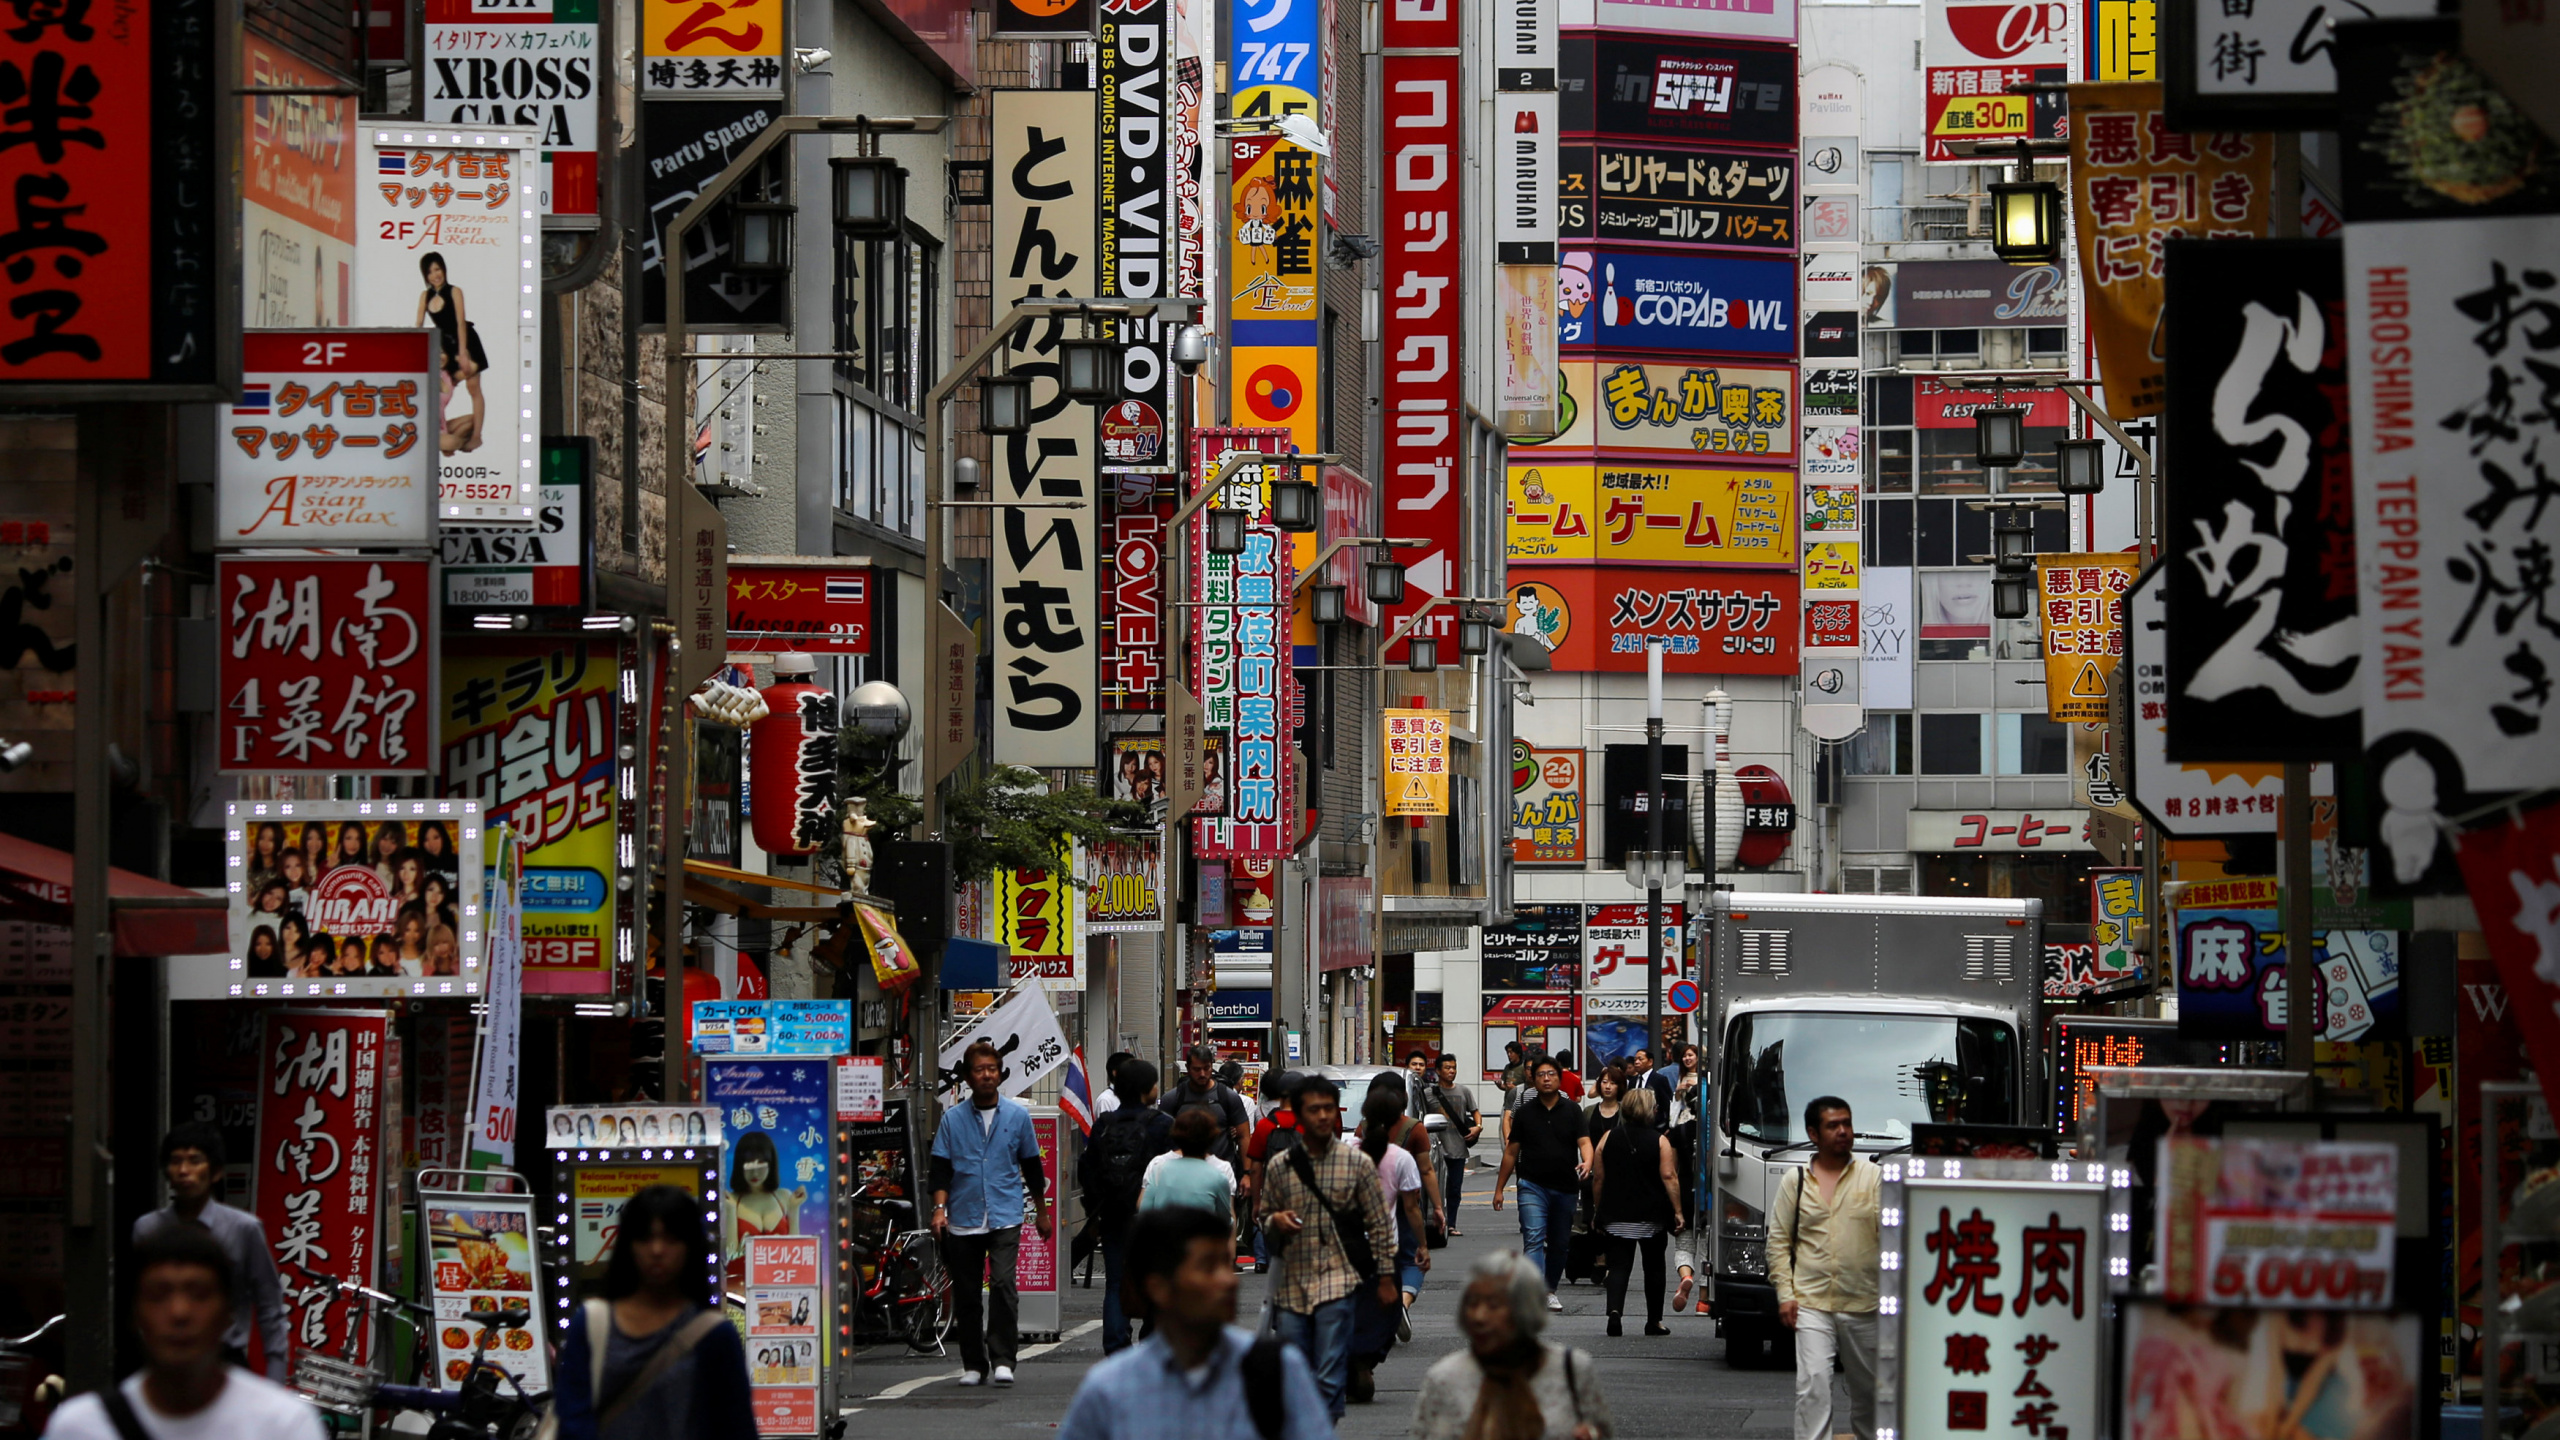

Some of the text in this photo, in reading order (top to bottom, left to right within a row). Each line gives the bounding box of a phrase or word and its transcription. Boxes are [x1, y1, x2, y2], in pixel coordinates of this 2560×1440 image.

[648, 58, 781, 88] 博多天神
[1239, 42, 1310, 81] 747
[433, 57, 592, 100] XROSS
[1520, 72, 1532, 86] 2
[1932, 68, 2028, 96] 新宿最大
[1809, 101, 1853, 114] Pavilion
[1947, 101, 2023, 128] 直進30m
[651, 108, 770, 179] Party Space
[1234, 142, 1261, 159] 3F
[2085, 112, 2256, 167] 悪質な
[409, 151, 510, 179] タイ古式
[1102, 23, 1115, 296] CS BS COMICS INTERNET MAGAZINE
[1516, 140, 1537, 229] MARUHAN
[1600, 152, 1790, 201] ビリヤード&ダーツ
[379, 183, 510, 208] マッサージ
[2087, 173, 2253, 227] 客引き
[1273, 147, 1314, 276] 麻雀
[380, 221, 415, 240] 2F
[408, 214, 482, 249] Asian
[1600, 211, 1658, 228] シミュレーション
[1658, 207, 1720, 239] ゴルフ
[1725, 215, 1790, 241] バグース
[1522, 247, 1529, 259] 1
[1635, 278, 1703, 294] 新宿コパボウル
[1520, 297, 1533, 357] 世界の料理
[302, 342, 347, 365] 2F
[1505, 316, 1515, 388] フードコート
[2368, 266, 2416, 455] HIROSHIMA
[1827, 369, 1857, 381] ダーツ
[275, 380, 418, 418] タイ古式
[1504, 394, 1545, 404] Universal City
[1602, 363, 1786, 430] まんが喫茶
[1809, 381, 1857, 394] ビリヤード
[1804, 406, 1842, 416] BAGUS
[1828, 395, 1857, 406] ゴルフ
[1002, 126, 1084, 732] とんかつにいむら
[1518, 413, 1532, 426] B1
[232, 424, 418, 460] マッサージ
[1692, 429, 1770, 455] ゲラゲラ
[1808, 464, 1855, 474] ボウリング
[302, 475, 412, 489] アジアンリラックス
[1602, 472, 1670, 490] 地域最大!!
[1743, 479, 1773, 489] メダル
[238, 475, 366, 535] Asian
[1740, 493, 1776, 504] クレーン
[1812, 488, 1856, 508] まんが
[302, 507, 398, 527] Relax
[1605, 494, 1723, 548] ゲーム
[1825, 508, 1856, 522] 喫茶
[1735, 521, 1781, 533] カードゲーム
[1733, 536, 1770, 548] プリクラ
[1807, 558, 1857, 576] ゲーム
[695, 528, 715, 651] 劇場通り一番街
[2046, 568, 2131, 595] 悪質な
[231, 563, 419, 671] 湖南
[1609, 587, 1781, 632] メンズサウナ
[1812, 604, 1851, 618] メンズ
[2047, 598, 2123, 626] 客引き
[829, 624, 864, 645] 2F
[1812, 618, 1851, 631] サウナ
[1611, 632, 1643, 654] 24H
[2048, 629, 2123, 657] に注意
[452, 640, 588, 726] キラリ
[1237, 534, 1275, 820] 歌舞伎町案内所
[948, 643, 965, 743] 劇場通り一番街
[271, 675, 416, 766] 菜館
[1390, 718, 1444, 735] 悪質な
[449, 697, 602, 812] 出会い
[1183, 713, 1196, 792] 劇場通り一番街
[1390, 737, 1444, 754] 客引き
[1390, 757, 1444, 773] に注意
[1545, 762, 1572, 777] 24
[513, 779, 611, 851] カフェ
[1533, 828, 1576, 847] 喫茶
[1954, 812, 2072, 848] コーヒー
[323, 873, 367, 899] community
[1098, 872, 1157, 919] 2,000円
[2177, 880, 2269, 906] 店舗掲載数
[329, 922, 395, 935] 出会いカフェ
[1239, 929, 1264, 940] Marlboro
[1484, 933, 1580, 946] ビリヤード&ダーツ
[1588, 928, 1641, 940] 地域最大!!
[1515, 949, 1550, 961] ゴルフ
[704, 1005, 762, 1017] カードOK!
[1206, 1003, 1260, 1016] menthol
[1486, 996, 1496, 1005] 7F
[1502, 999, 1572, 1009] FACE
[1599, 1000, 1648, 1009] メンズサウナ
[347, 1029, 377, 1215] 中国湖南省 本場料理
[851, 1126, 902, 1137] Kitchen Diner
[580, 1171, 660, 1182] Welcome Foreigner
[580, 1183, 633, 1194] Traditional
[755, 1245, 815, 1266] 当ビル2階
[1924, 1206, 2086, 1321] 焼肉
[440, 1265, 462, 1289] 昼
[773, 1270, 797, 1283] 2F
[1944, 1332, 1990, 1430] 韓国
